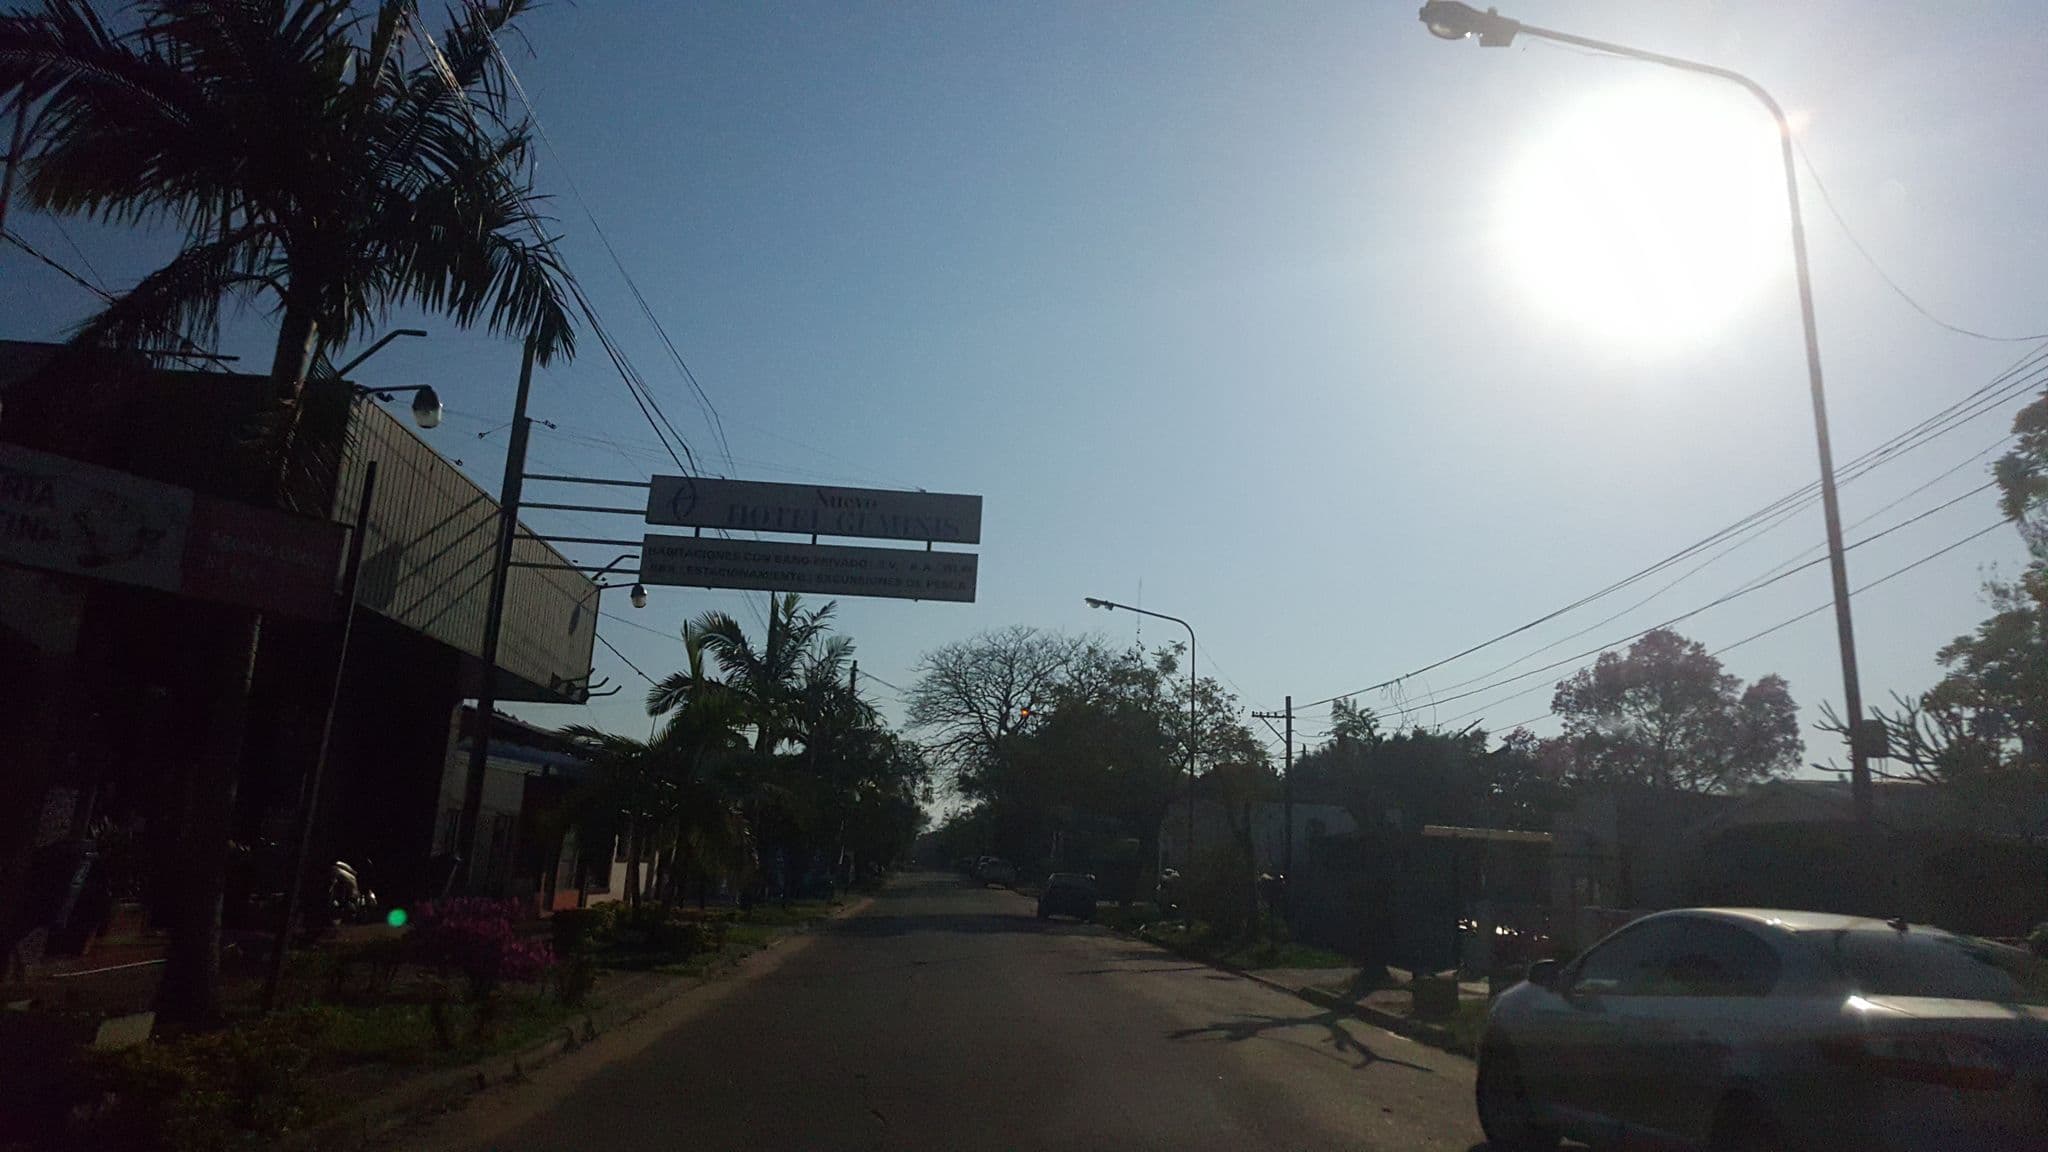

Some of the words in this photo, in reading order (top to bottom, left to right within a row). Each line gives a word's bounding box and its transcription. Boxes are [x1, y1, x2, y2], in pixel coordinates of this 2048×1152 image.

[816, 488, 878, 509] Nuevo
[726, 502, 823, 532] HOTEL
[647, 546, 741, 562] HABITACIONES
[743, 550, 770, 563] CON
